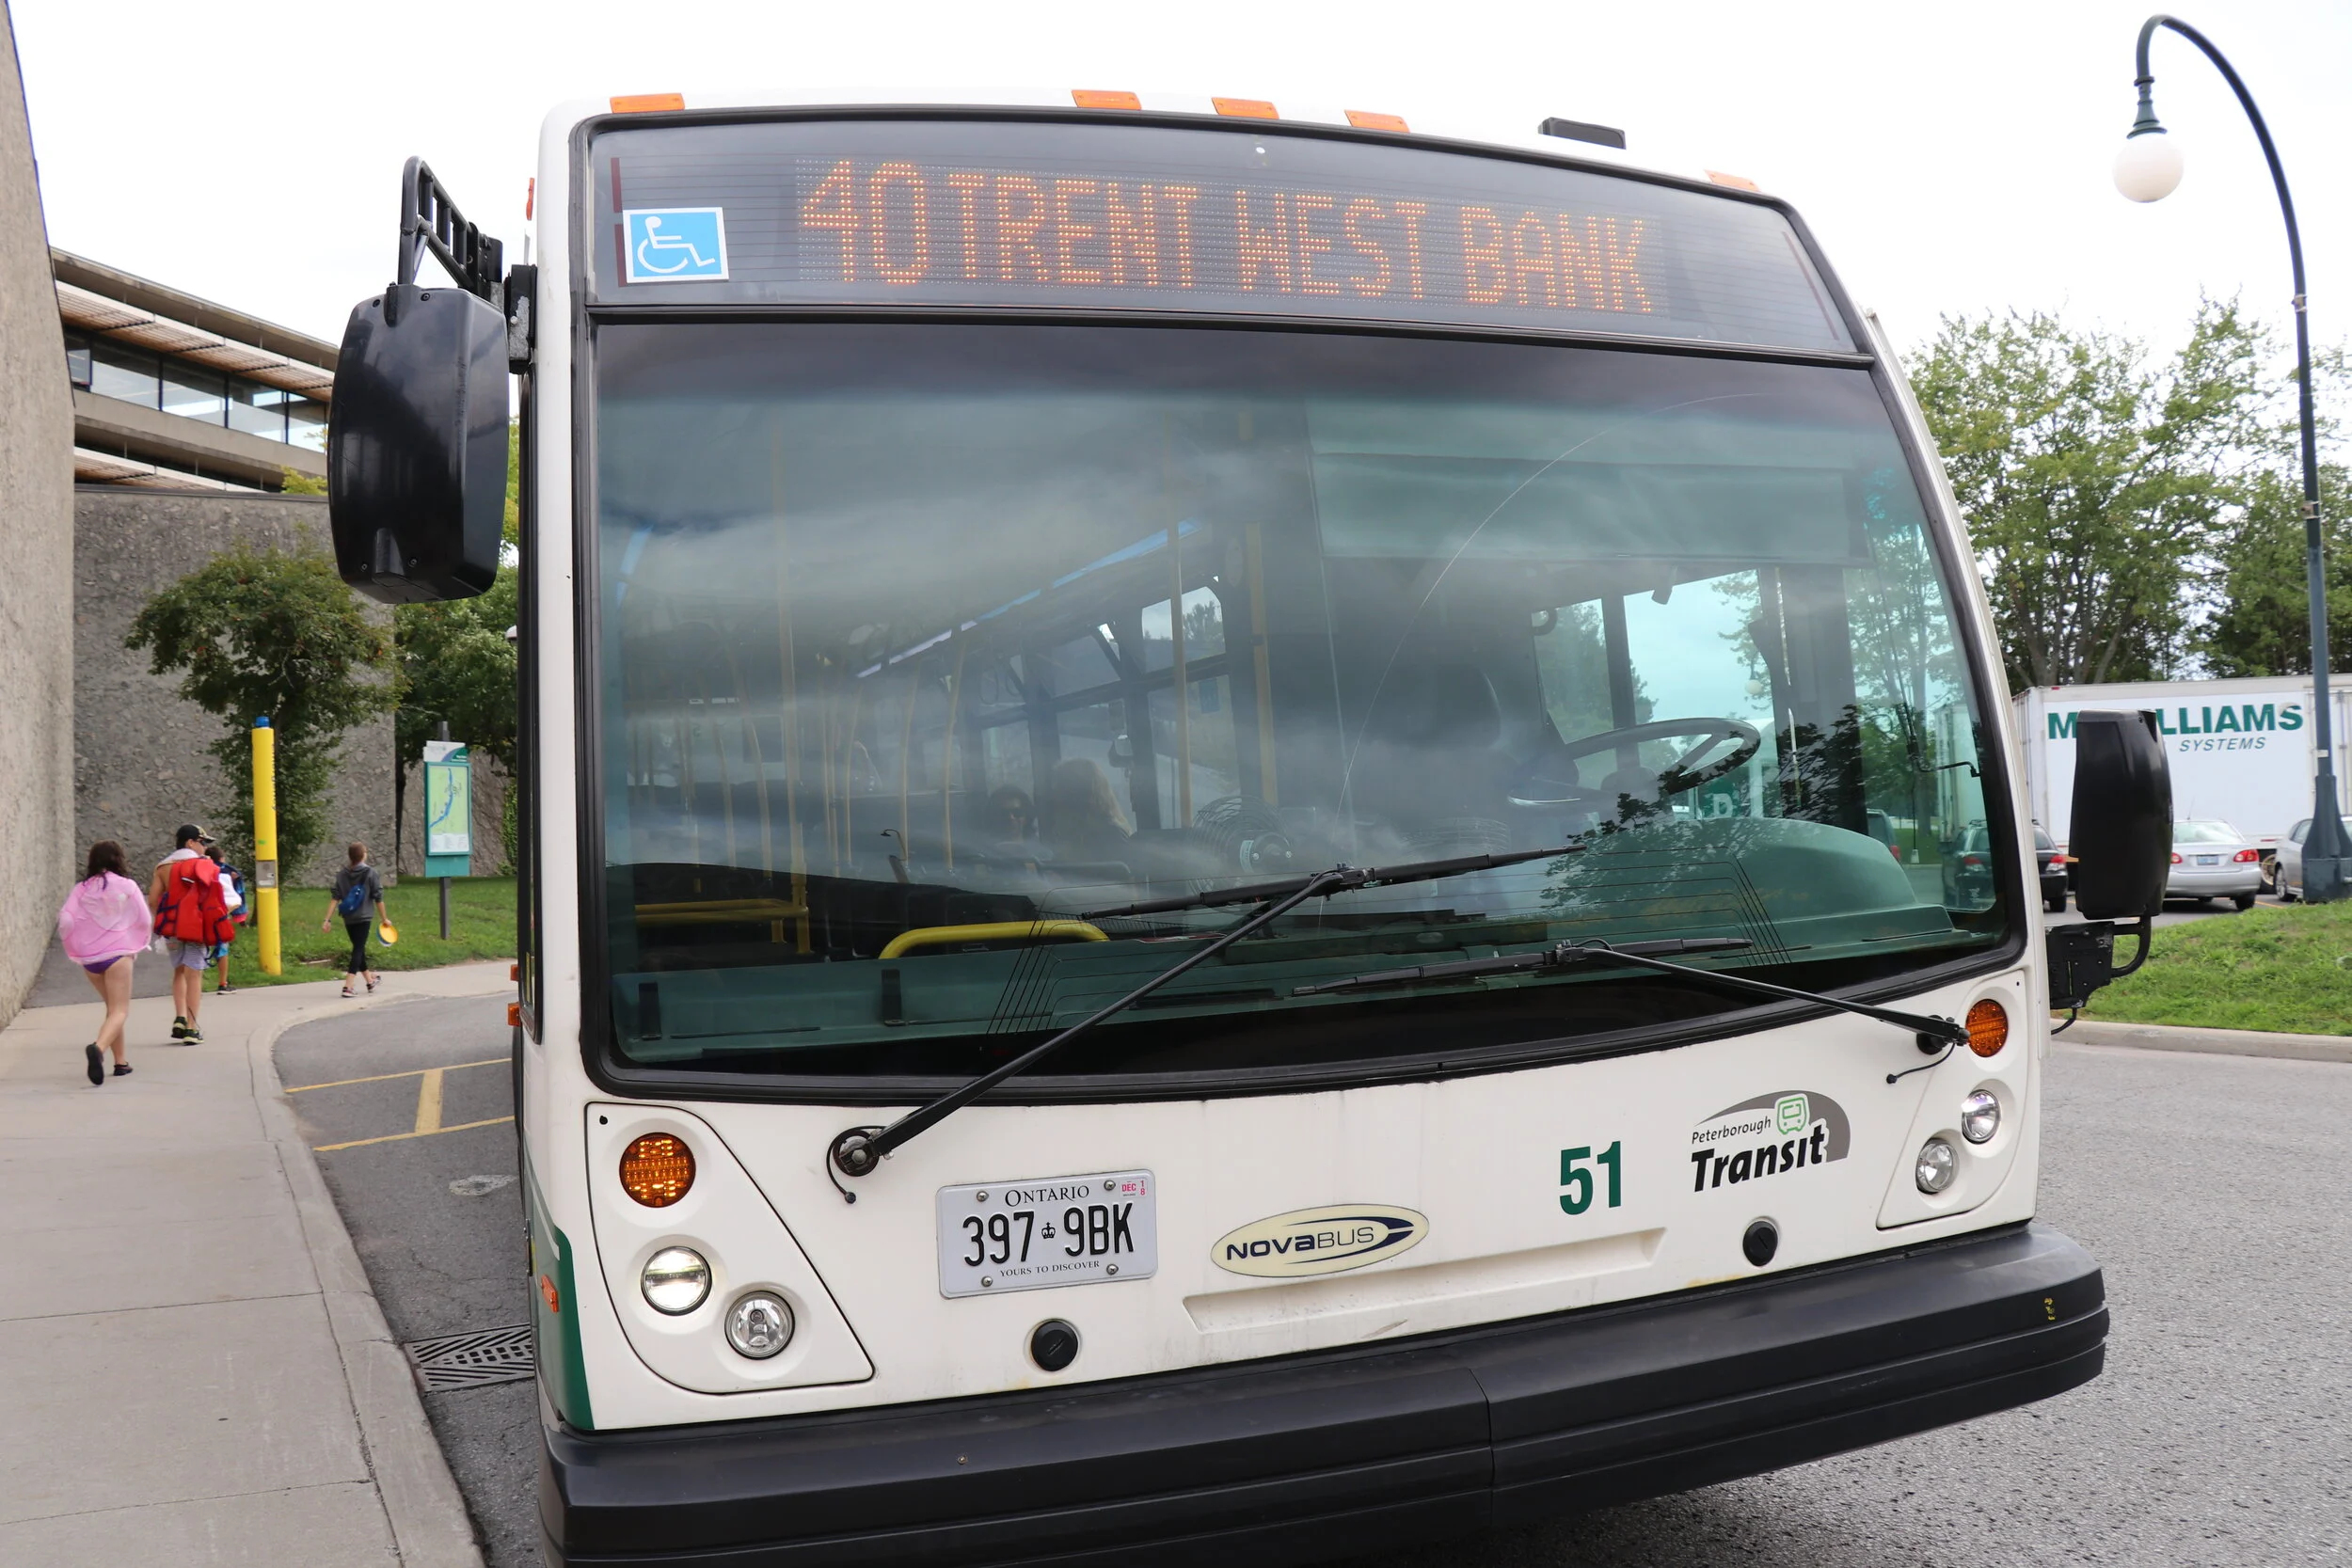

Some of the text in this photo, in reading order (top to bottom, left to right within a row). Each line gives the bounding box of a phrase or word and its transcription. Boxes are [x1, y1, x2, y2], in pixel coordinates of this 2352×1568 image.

[801, 159, 1652, 313] 40 TRENT WEST BANK
[2179, 736, 2266, 752] SYSTEMS
[1691, 1117, 1772, 1145] Peterborough
[1691, 1124, 1825, 1193] Transit
[1121, 1182, 1136, 1193] DEC
[1559, 1140, 1622, 1216] 51
[1004, 1184, 1090, 1208] ONTARIO
[961, 1202, 1135, 1267] 397 9BK
[1000, 1259, 1100, 1277] YOURS TO DISCOVER
